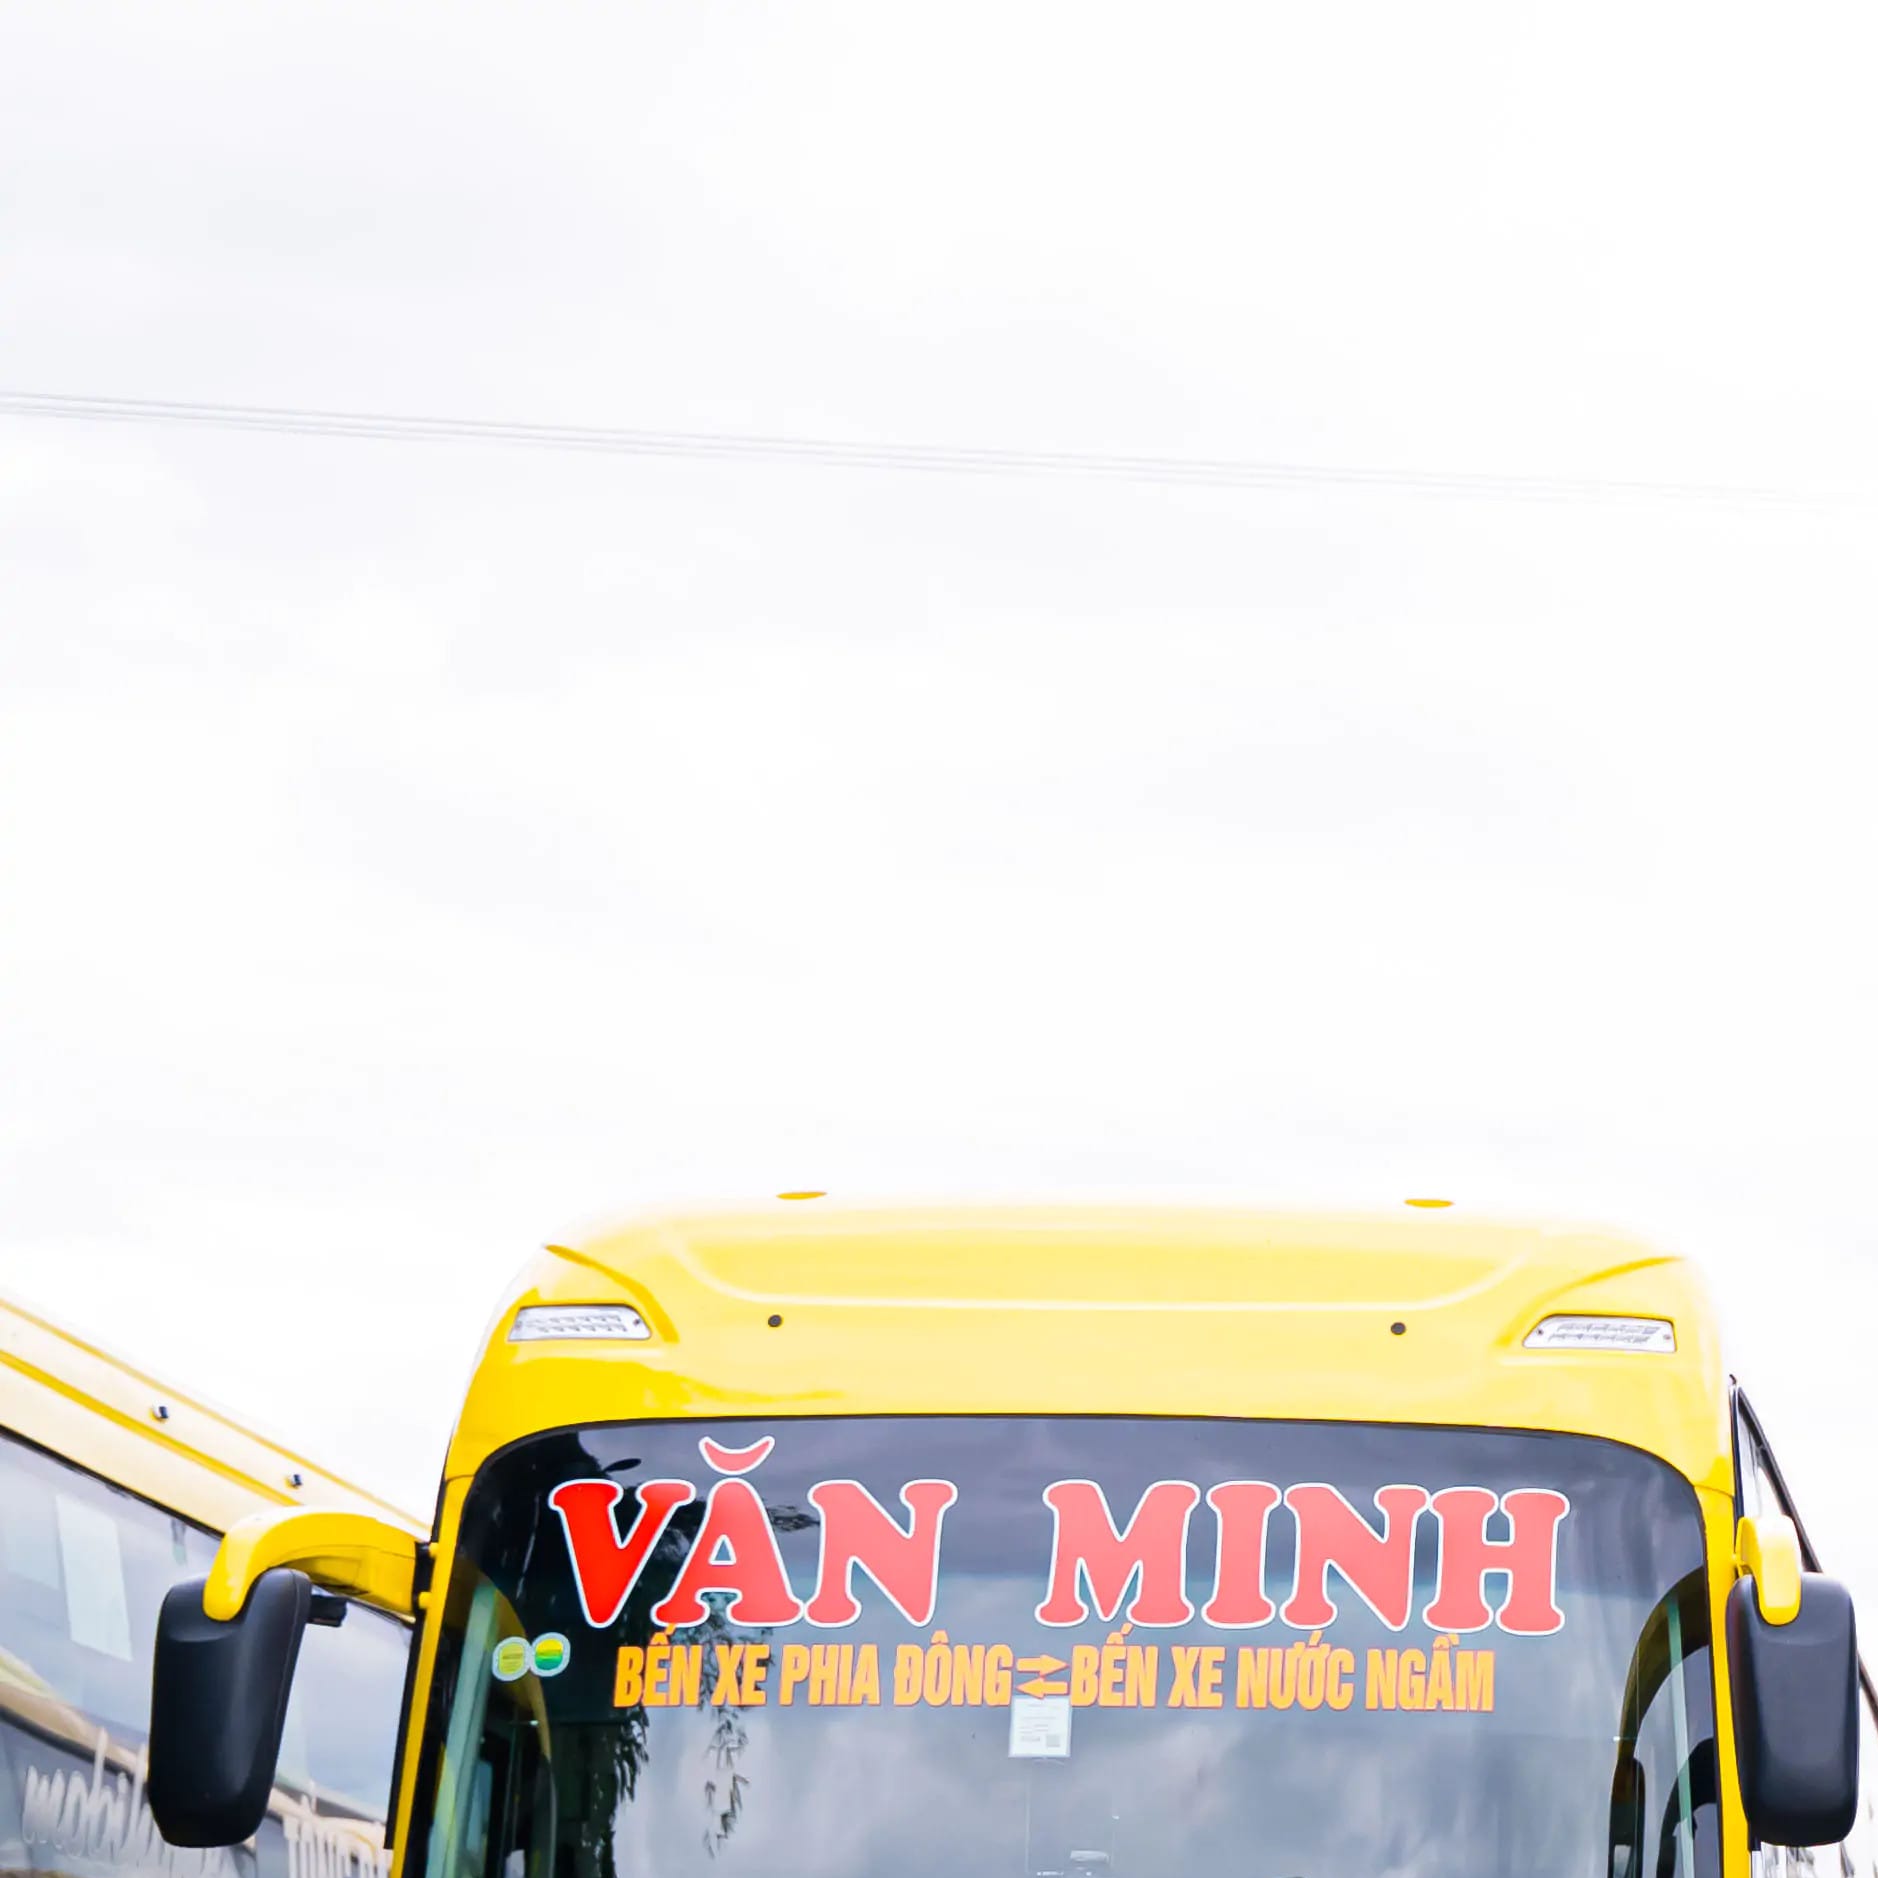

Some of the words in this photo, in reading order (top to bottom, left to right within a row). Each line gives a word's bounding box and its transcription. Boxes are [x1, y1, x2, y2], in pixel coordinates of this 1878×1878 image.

[549, 1435, 957, 1628] VĂN
[1034, 1478, 1571, 1635] MINH
[613, 1623, 702, 1707] BẾN
[711, 1644, 771, 1707] XE
[778, 1644, 880, 1706] PHIA
[893, 1630, 1013, 1707] ĐÔNG
[1071, 1623, 1159, 1708] BẾN
[1171, 1645, 1225, 1708] XE
[1237, 1629, 1353, 1711] NƯỚC
[1366, 1633, 1495, 1712] NGẦM
